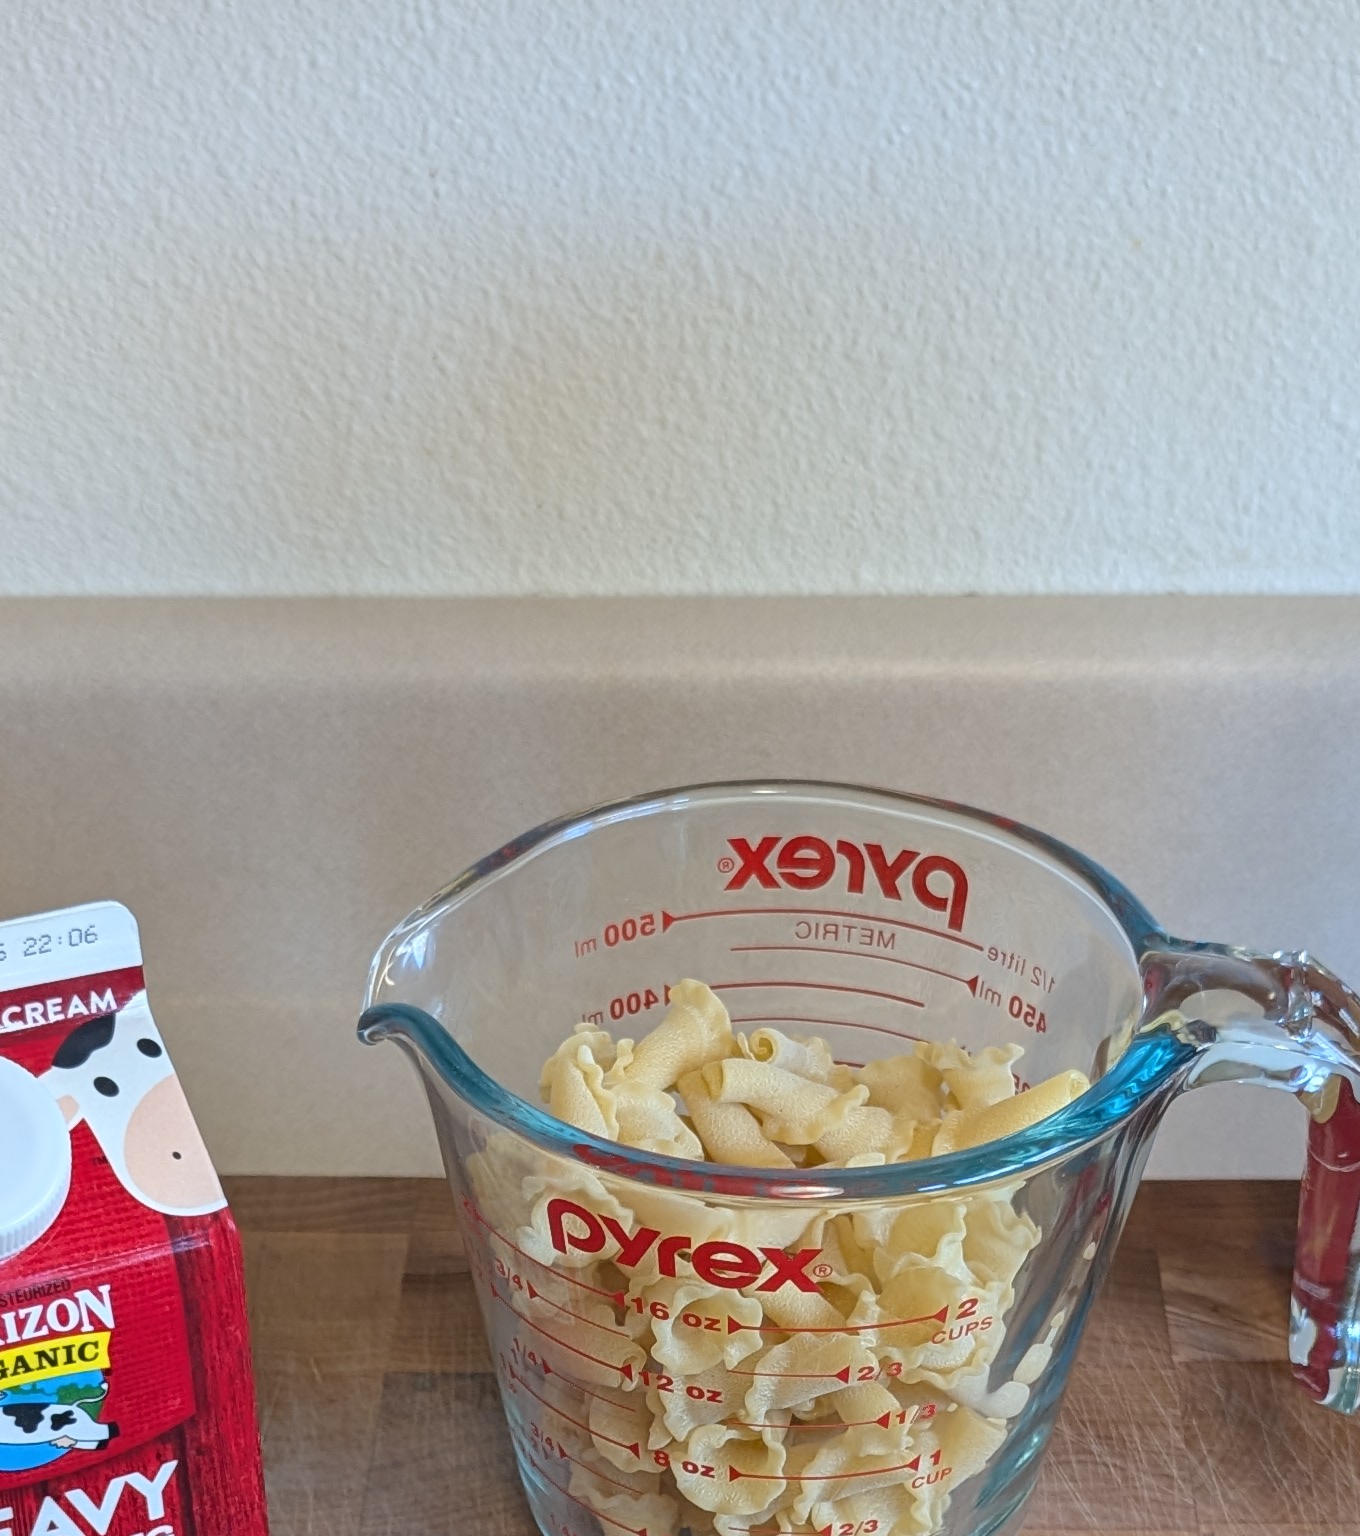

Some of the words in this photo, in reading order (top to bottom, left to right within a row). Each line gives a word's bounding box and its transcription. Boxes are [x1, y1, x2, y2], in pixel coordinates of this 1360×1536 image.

[23, 925, 99, 957] 22:06
[1, 988, 117, 1028] CREAM
[547, 1198, 824, 1293] pyrex
[631, 1297, 669, 1320] 16
[682, 1313, 721, 1332] oz
[956, 1298, 979, 1321] 2
[931, 1316, 993, 1345] CUPS
[857, 1362, 903, 1381] 2/3
[638, 1371, 674, 1393] 12
[686, 1386, 723, 1403] oz
[895, 1404, 936, 1425] 1/3
[654, 1450, 670, 1467] 8
[682, 1461, 715, 1479] oz
[929, 1449, 941, 1466] 1
[911, 1467, 953, 1489] CUP
[838, 1520, 878, 1536] 2/3
